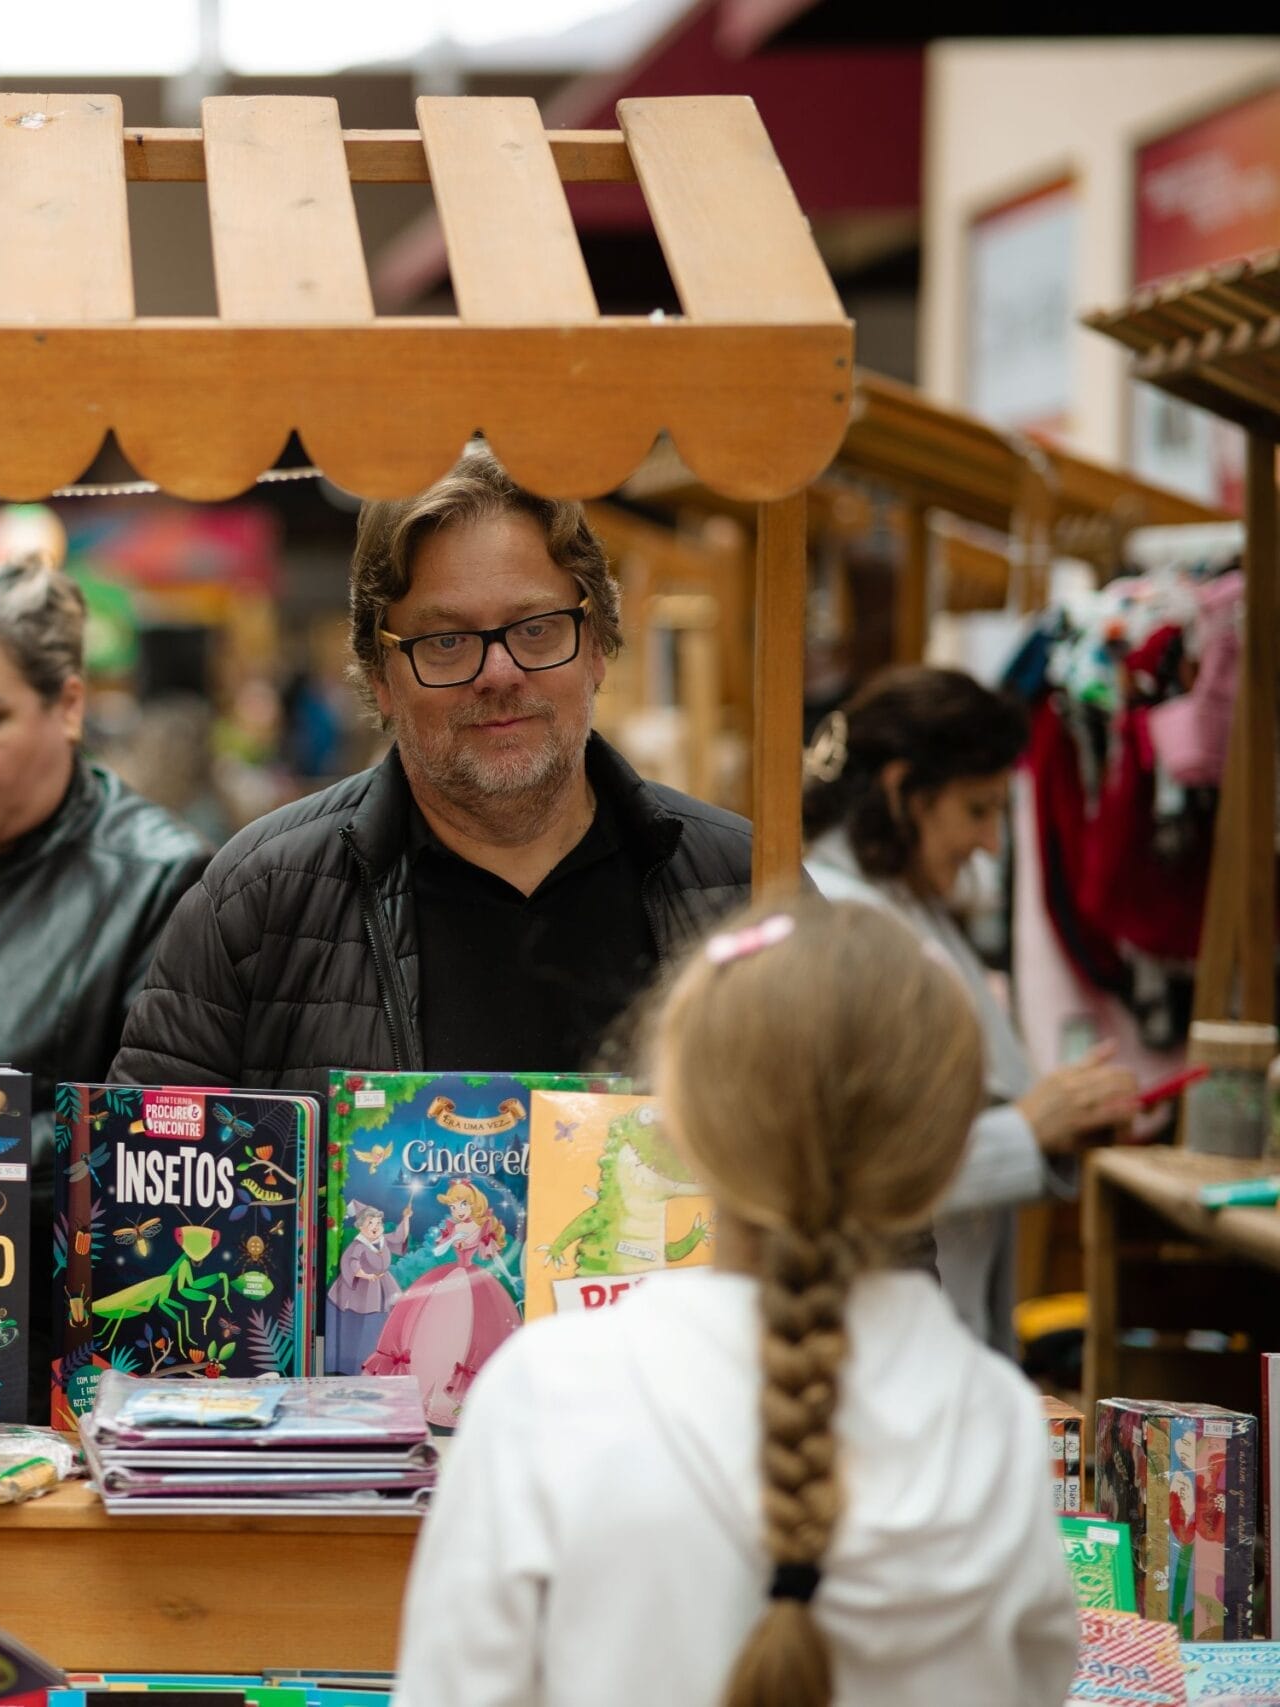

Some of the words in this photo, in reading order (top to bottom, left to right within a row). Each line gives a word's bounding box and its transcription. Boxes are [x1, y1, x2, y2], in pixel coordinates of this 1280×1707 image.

[145, 1104, 188, 1120] PROCURE
[153, 1121, 201, 1137] ENCONTRE
[442, 1114, 461, 1129] ERA
[463, 1121, 484, 1130] UMA
[116, 1142, 235, 1209] INSETOS
